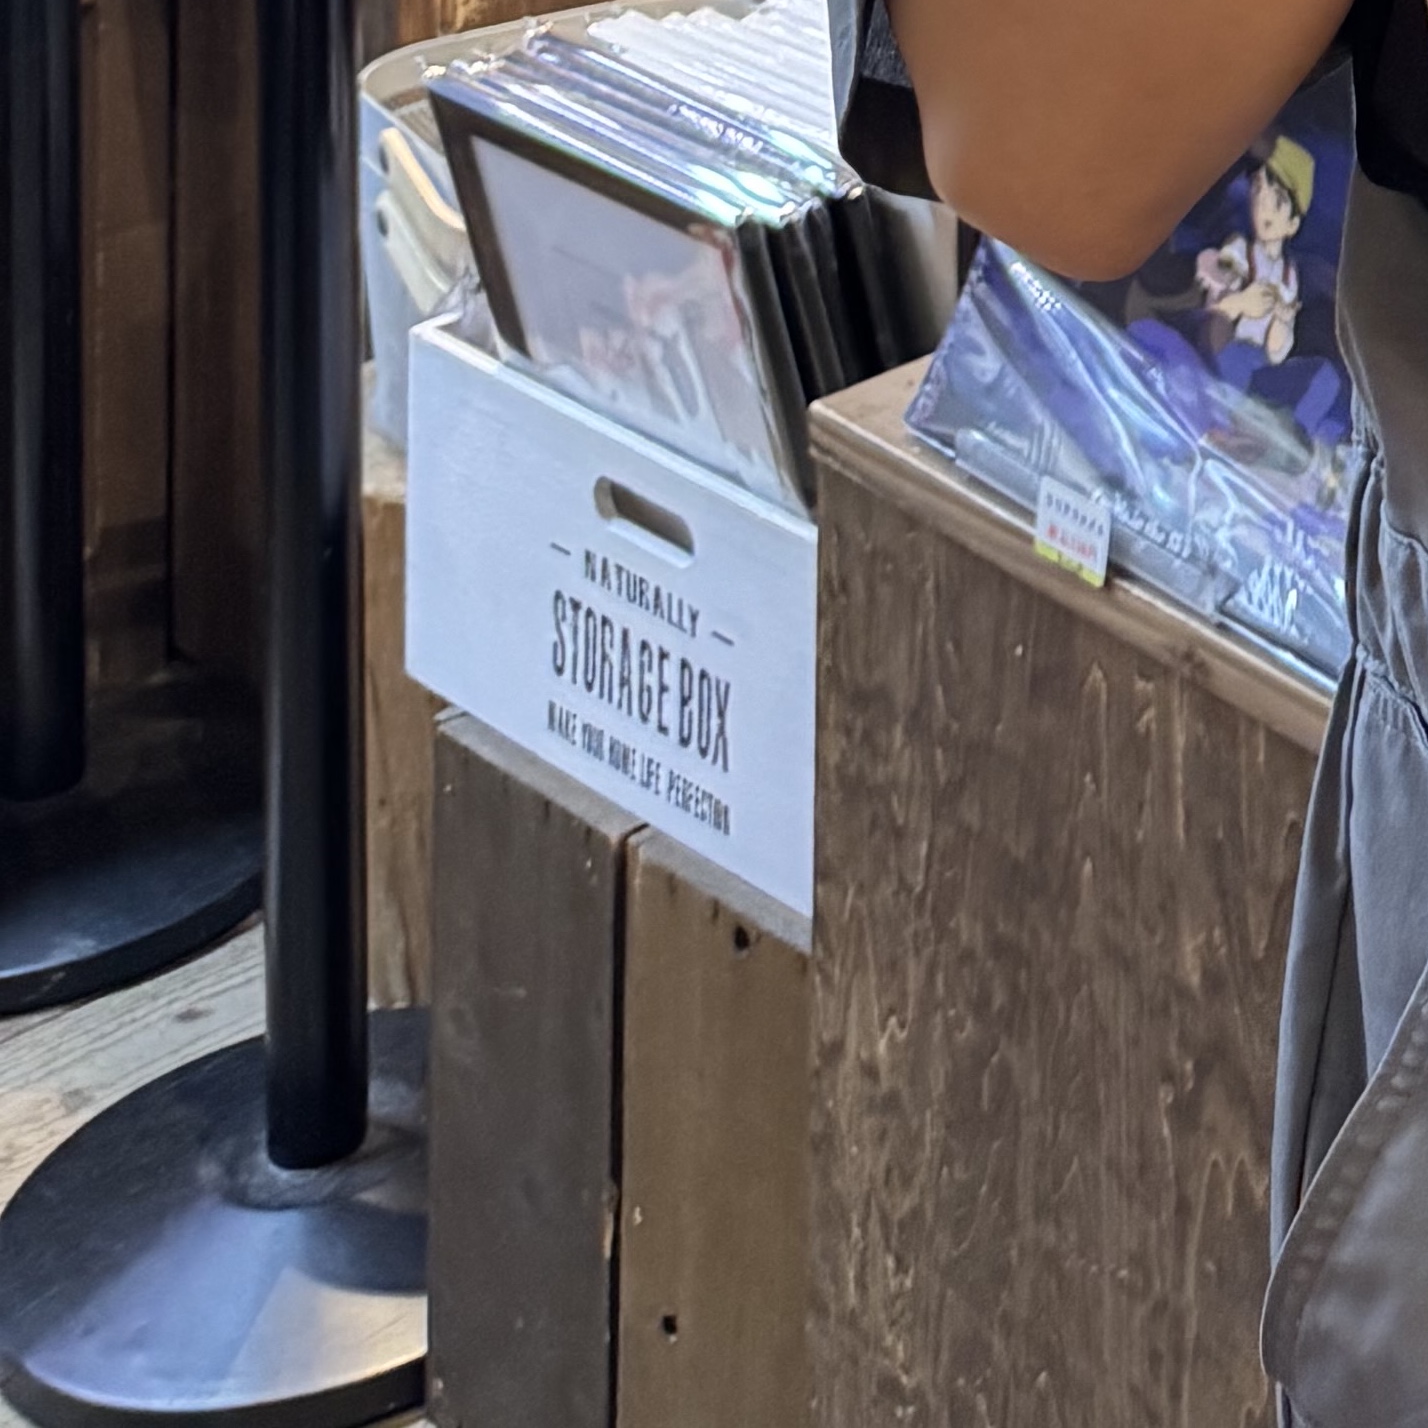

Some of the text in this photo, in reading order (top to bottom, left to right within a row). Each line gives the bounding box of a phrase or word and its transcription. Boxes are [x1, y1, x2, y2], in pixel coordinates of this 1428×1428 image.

[583, 548, 700, 639] NATURALLY
[552, 588, 731, 774] STORAGE BOX
[547, 698, 578, 746] MAKE
[640, 752, 662, 797] LIFE
